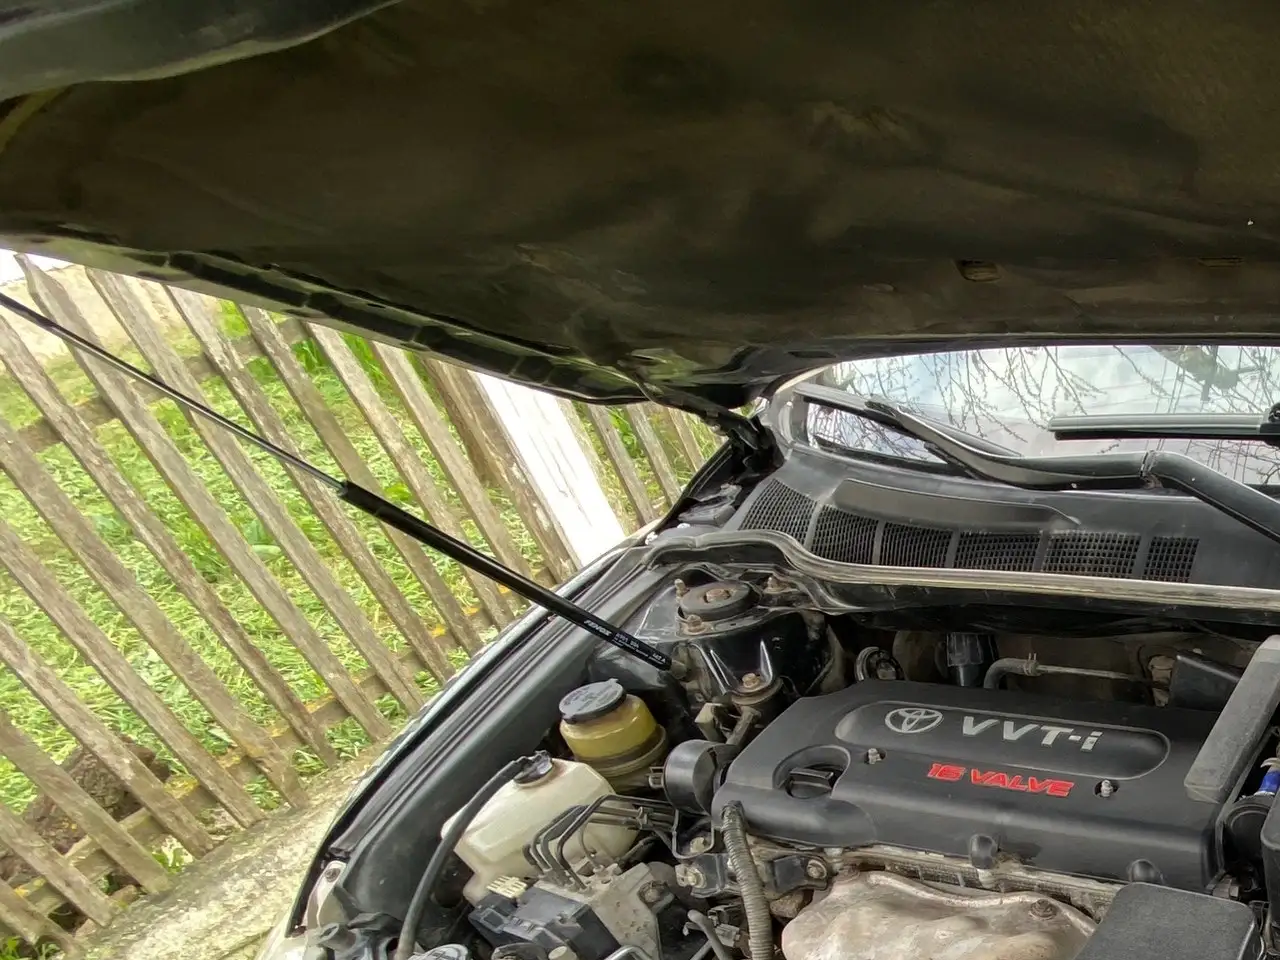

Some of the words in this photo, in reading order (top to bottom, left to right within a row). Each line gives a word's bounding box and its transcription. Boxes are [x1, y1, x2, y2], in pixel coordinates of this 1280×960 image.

[962, 715, 1104, 752] VVT-i
[926, 762, 967, 783] 16
[970, 767, 1075, 798] VALVE
